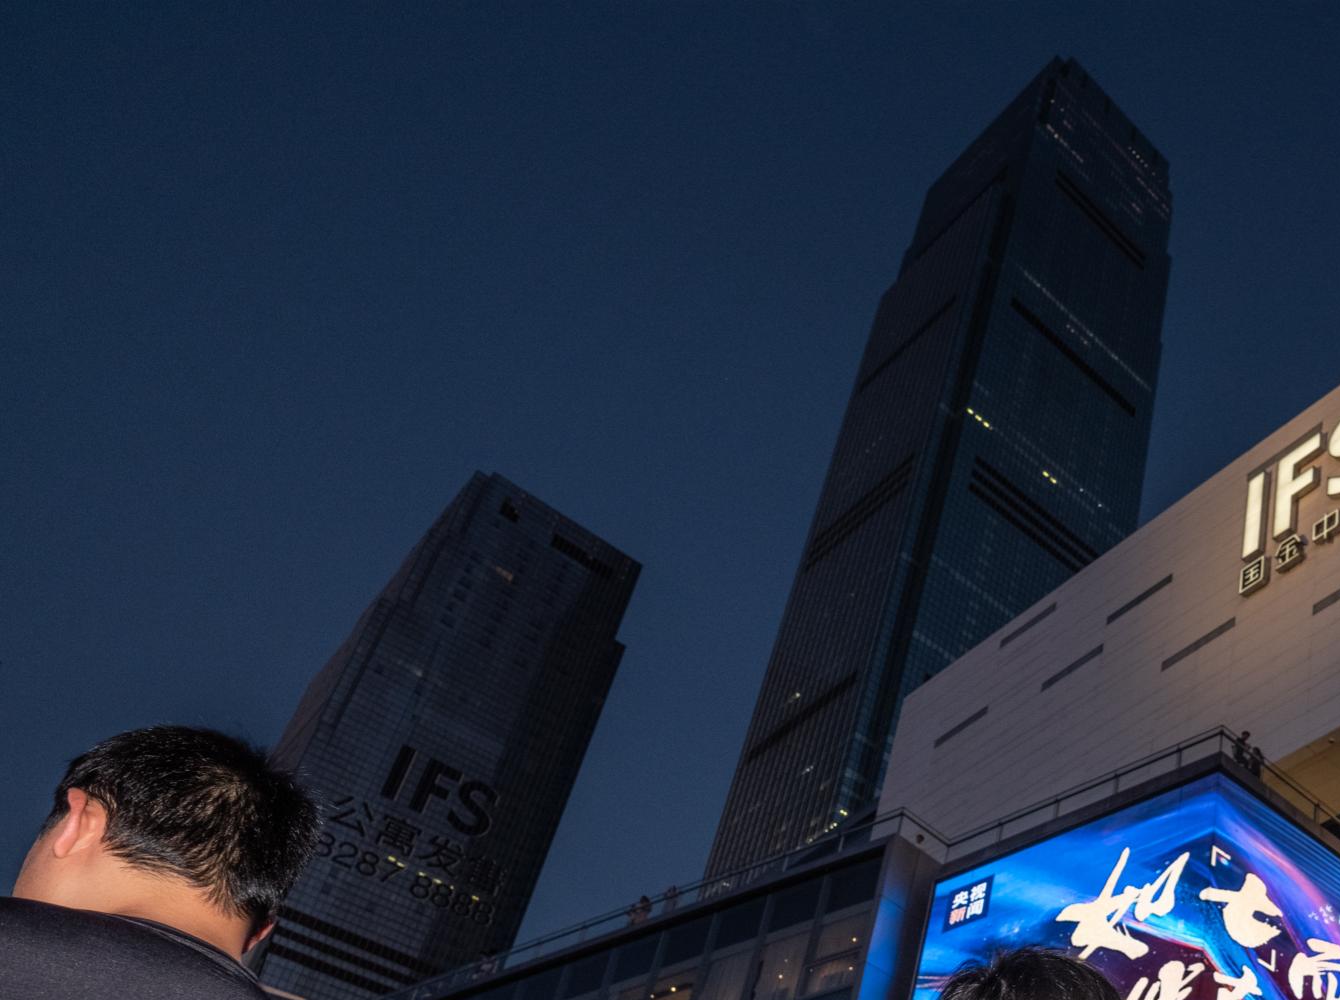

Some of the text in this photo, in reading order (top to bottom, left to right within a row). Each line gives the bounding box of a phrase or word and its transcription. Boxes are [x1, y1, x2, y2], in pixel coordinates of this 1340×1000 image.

[380, 745, 500, 838] IFS
[952, 882, 987, 909] 央视
[949, 899, 984, 925] 新闻
